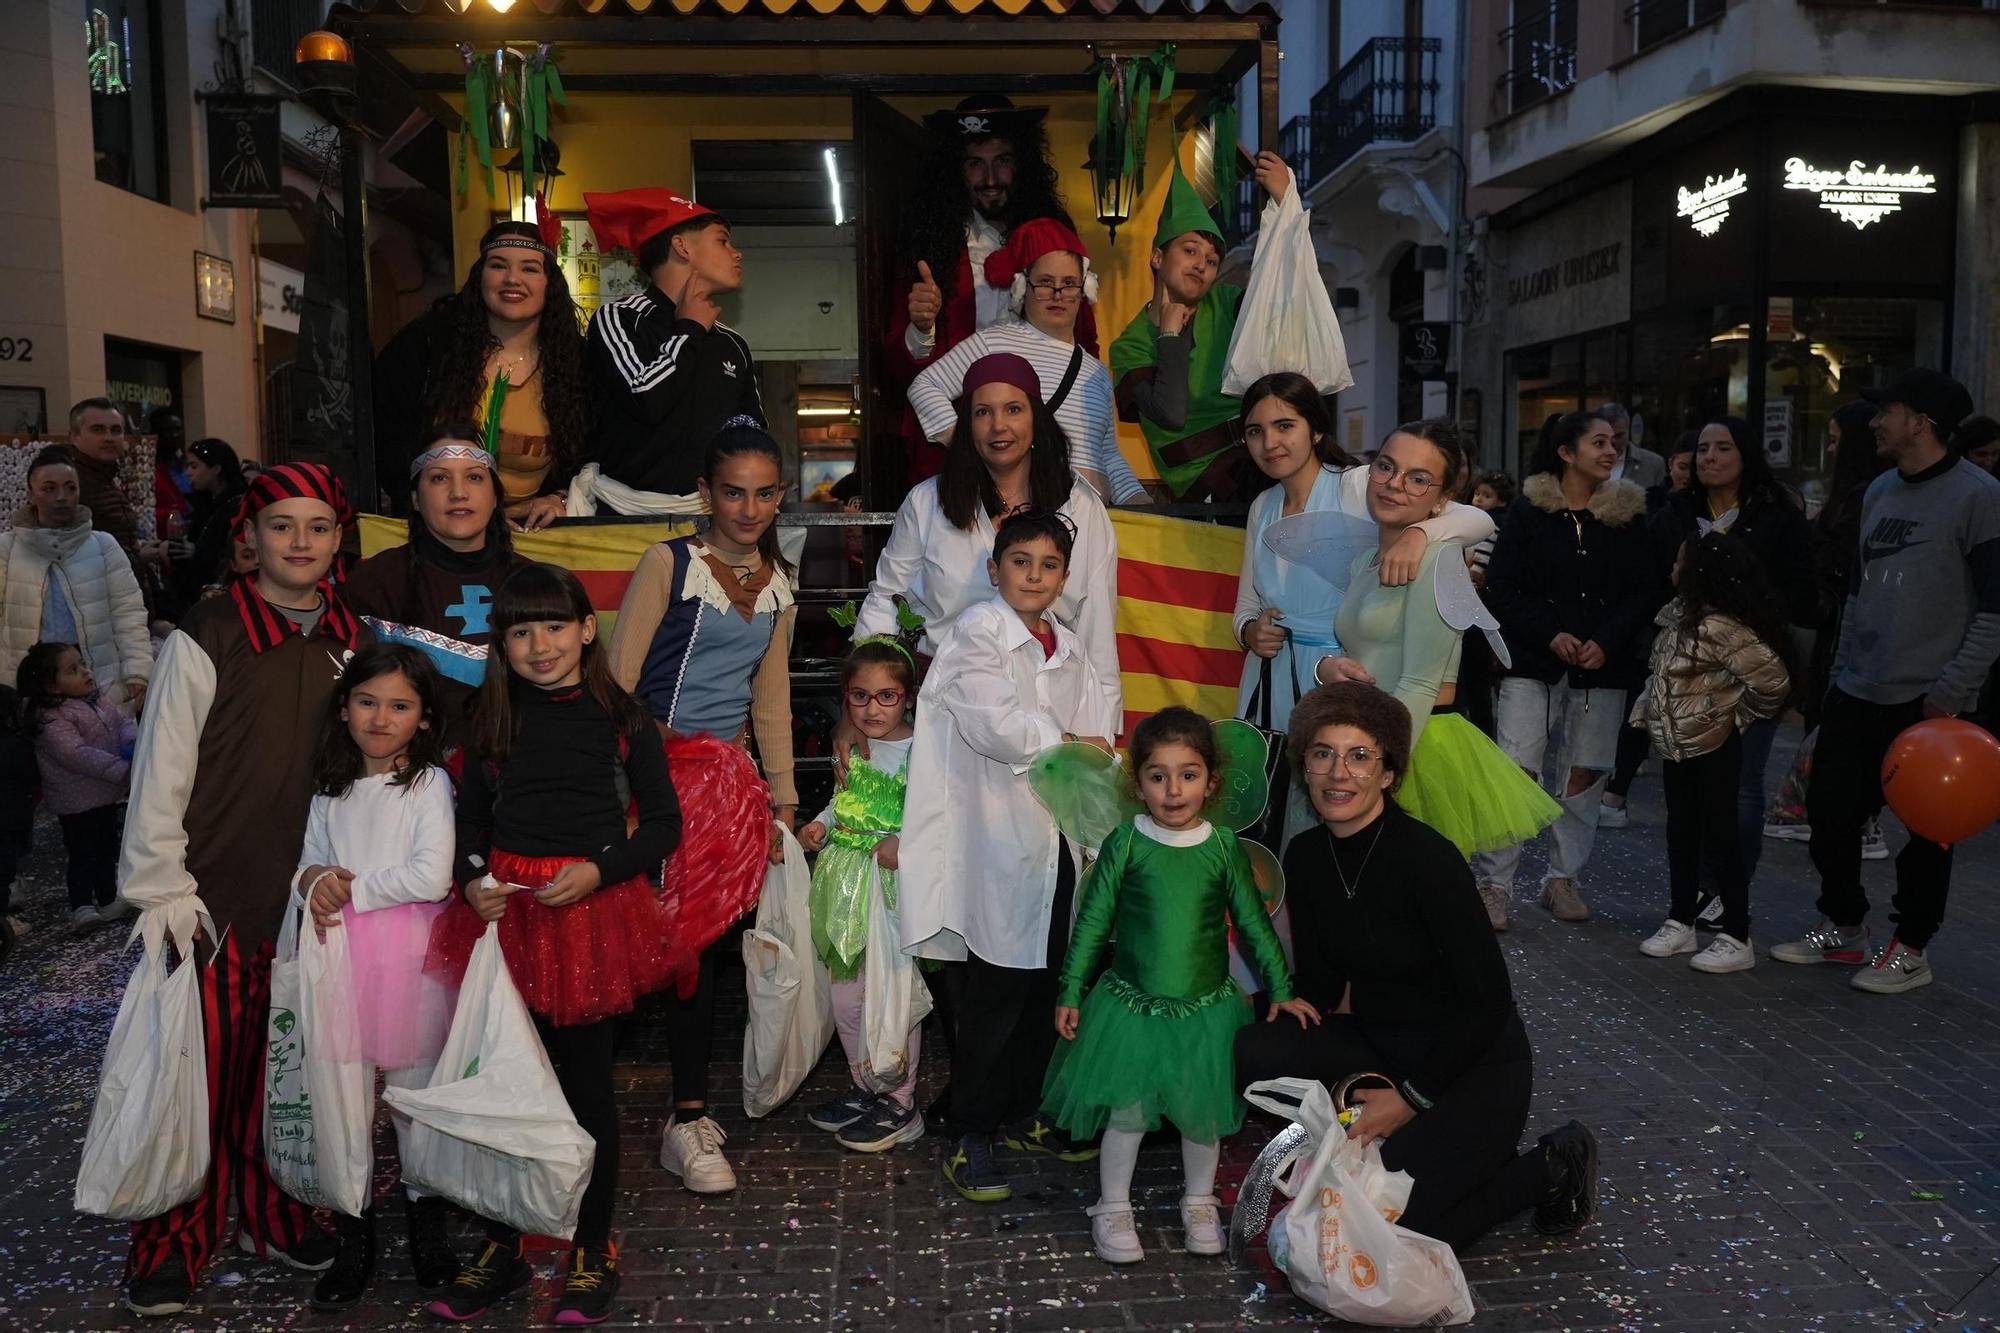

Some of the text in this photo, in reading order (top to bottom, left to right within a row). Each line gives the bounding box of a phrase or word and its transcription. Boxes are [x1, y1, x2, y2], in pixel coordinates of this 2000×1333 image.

[1508, 242, 1622, 307] SALOON UNISEX
[0, 336, 33, 362] 92
[1871, 517, 1919, 545] NIKE
